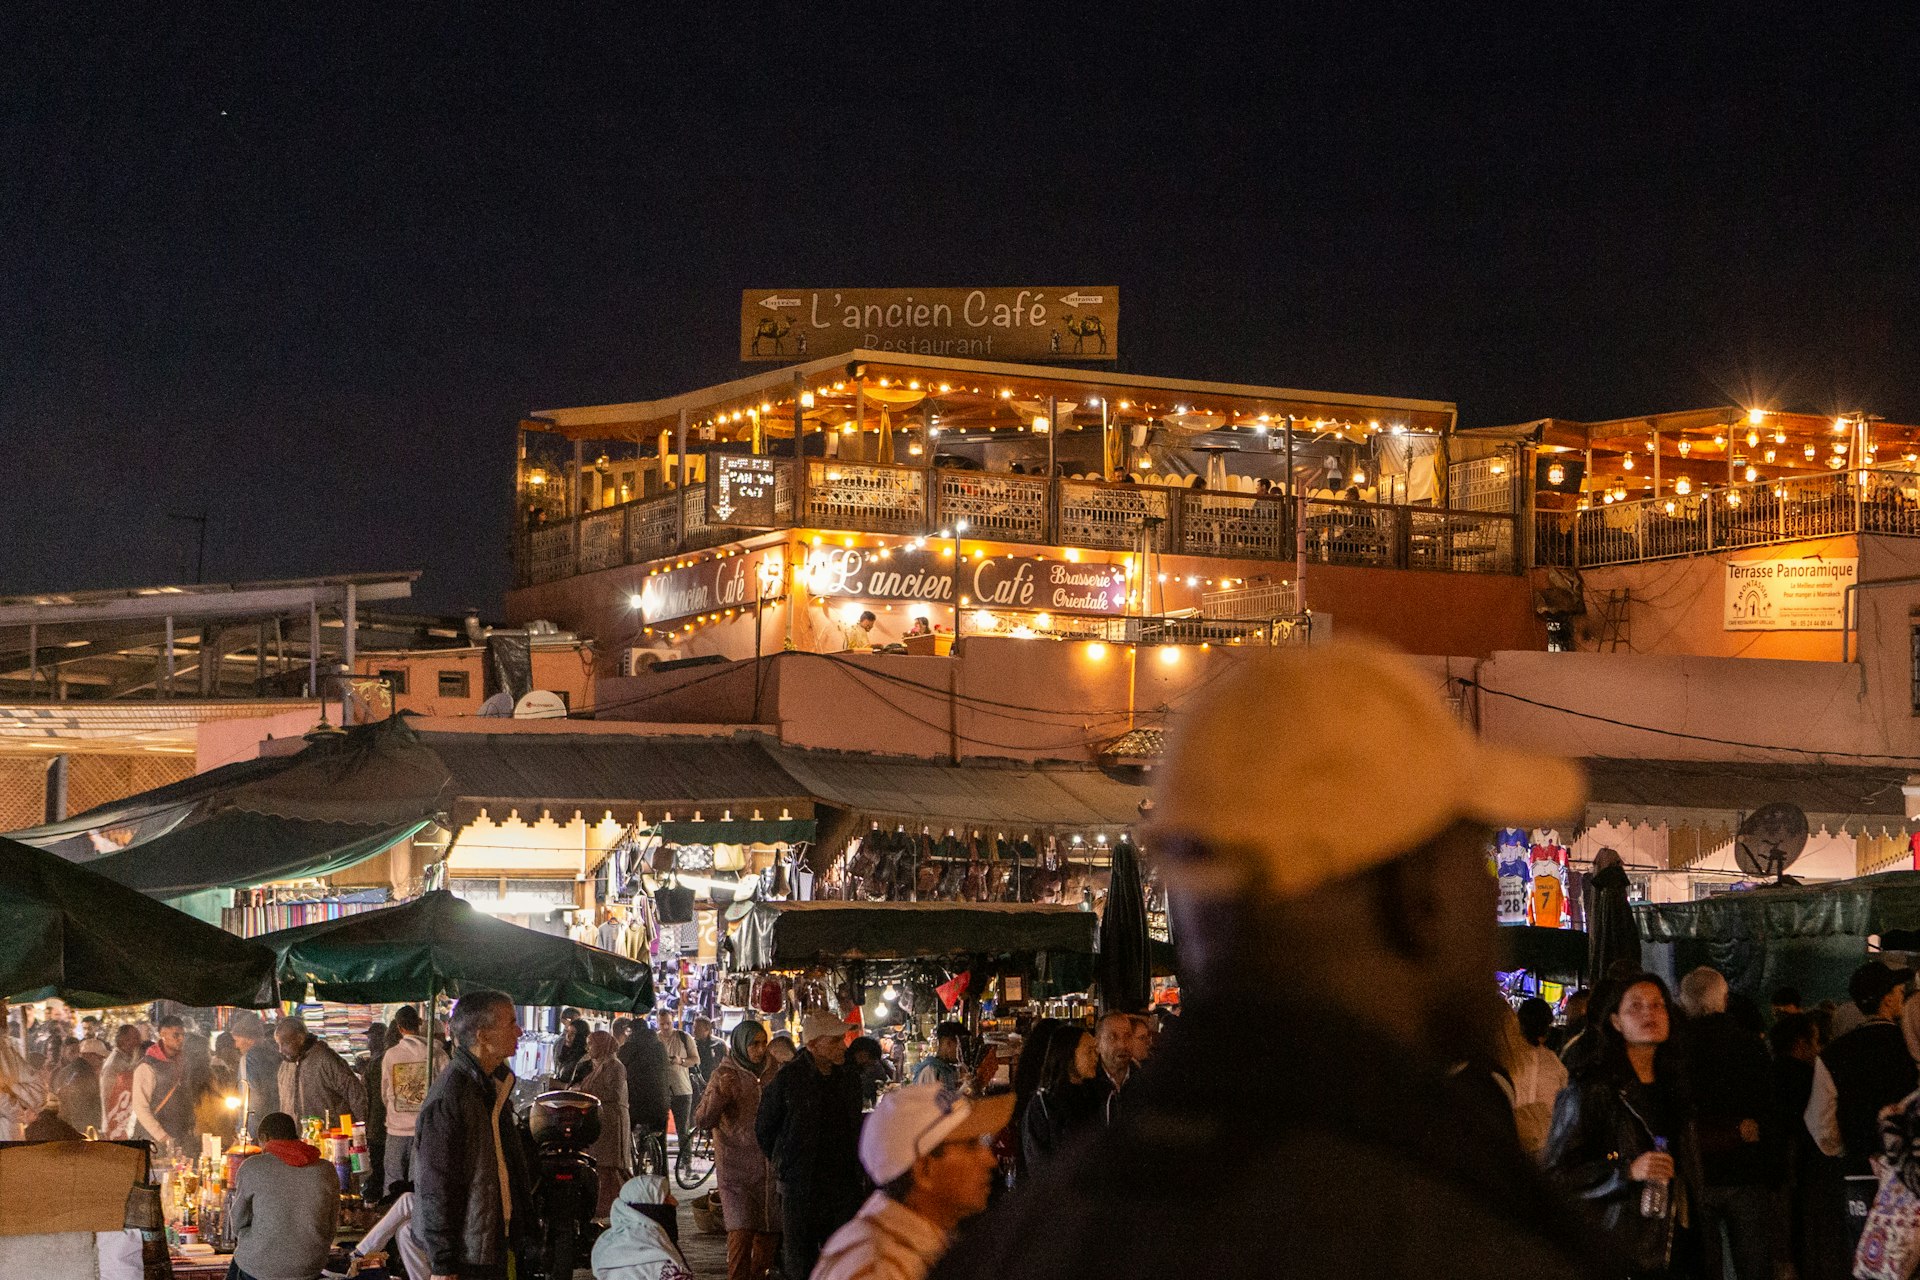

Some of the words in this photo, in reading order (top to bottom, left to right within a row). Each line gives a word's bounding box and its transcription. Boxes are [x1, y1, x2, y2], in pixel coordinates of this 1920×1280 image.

[811, 293, 953, 329] L'ancien
[963, 290, 1047, 328] Café
[863, 334, 993, 354] Restaurant
[716, 558, 745, 605] Café
[828, 549, 952, 599] L'ancien
[973, 559, 1034, 605] Café
[1050, 564, 1111, 588] Brasserie
[1729, 564, 1773, 579] Terrasse
[1777, 562, 1853, 580] Panoramique
[1052, 588, 1109, 610] Orientale
[1738, 579, 1768, 600] MONTASSIR
[1817, 590, 1841, 598] Marrakech
[1504, 899, 1520, 913] 28
[1541, 891, 1550, 909] 7
